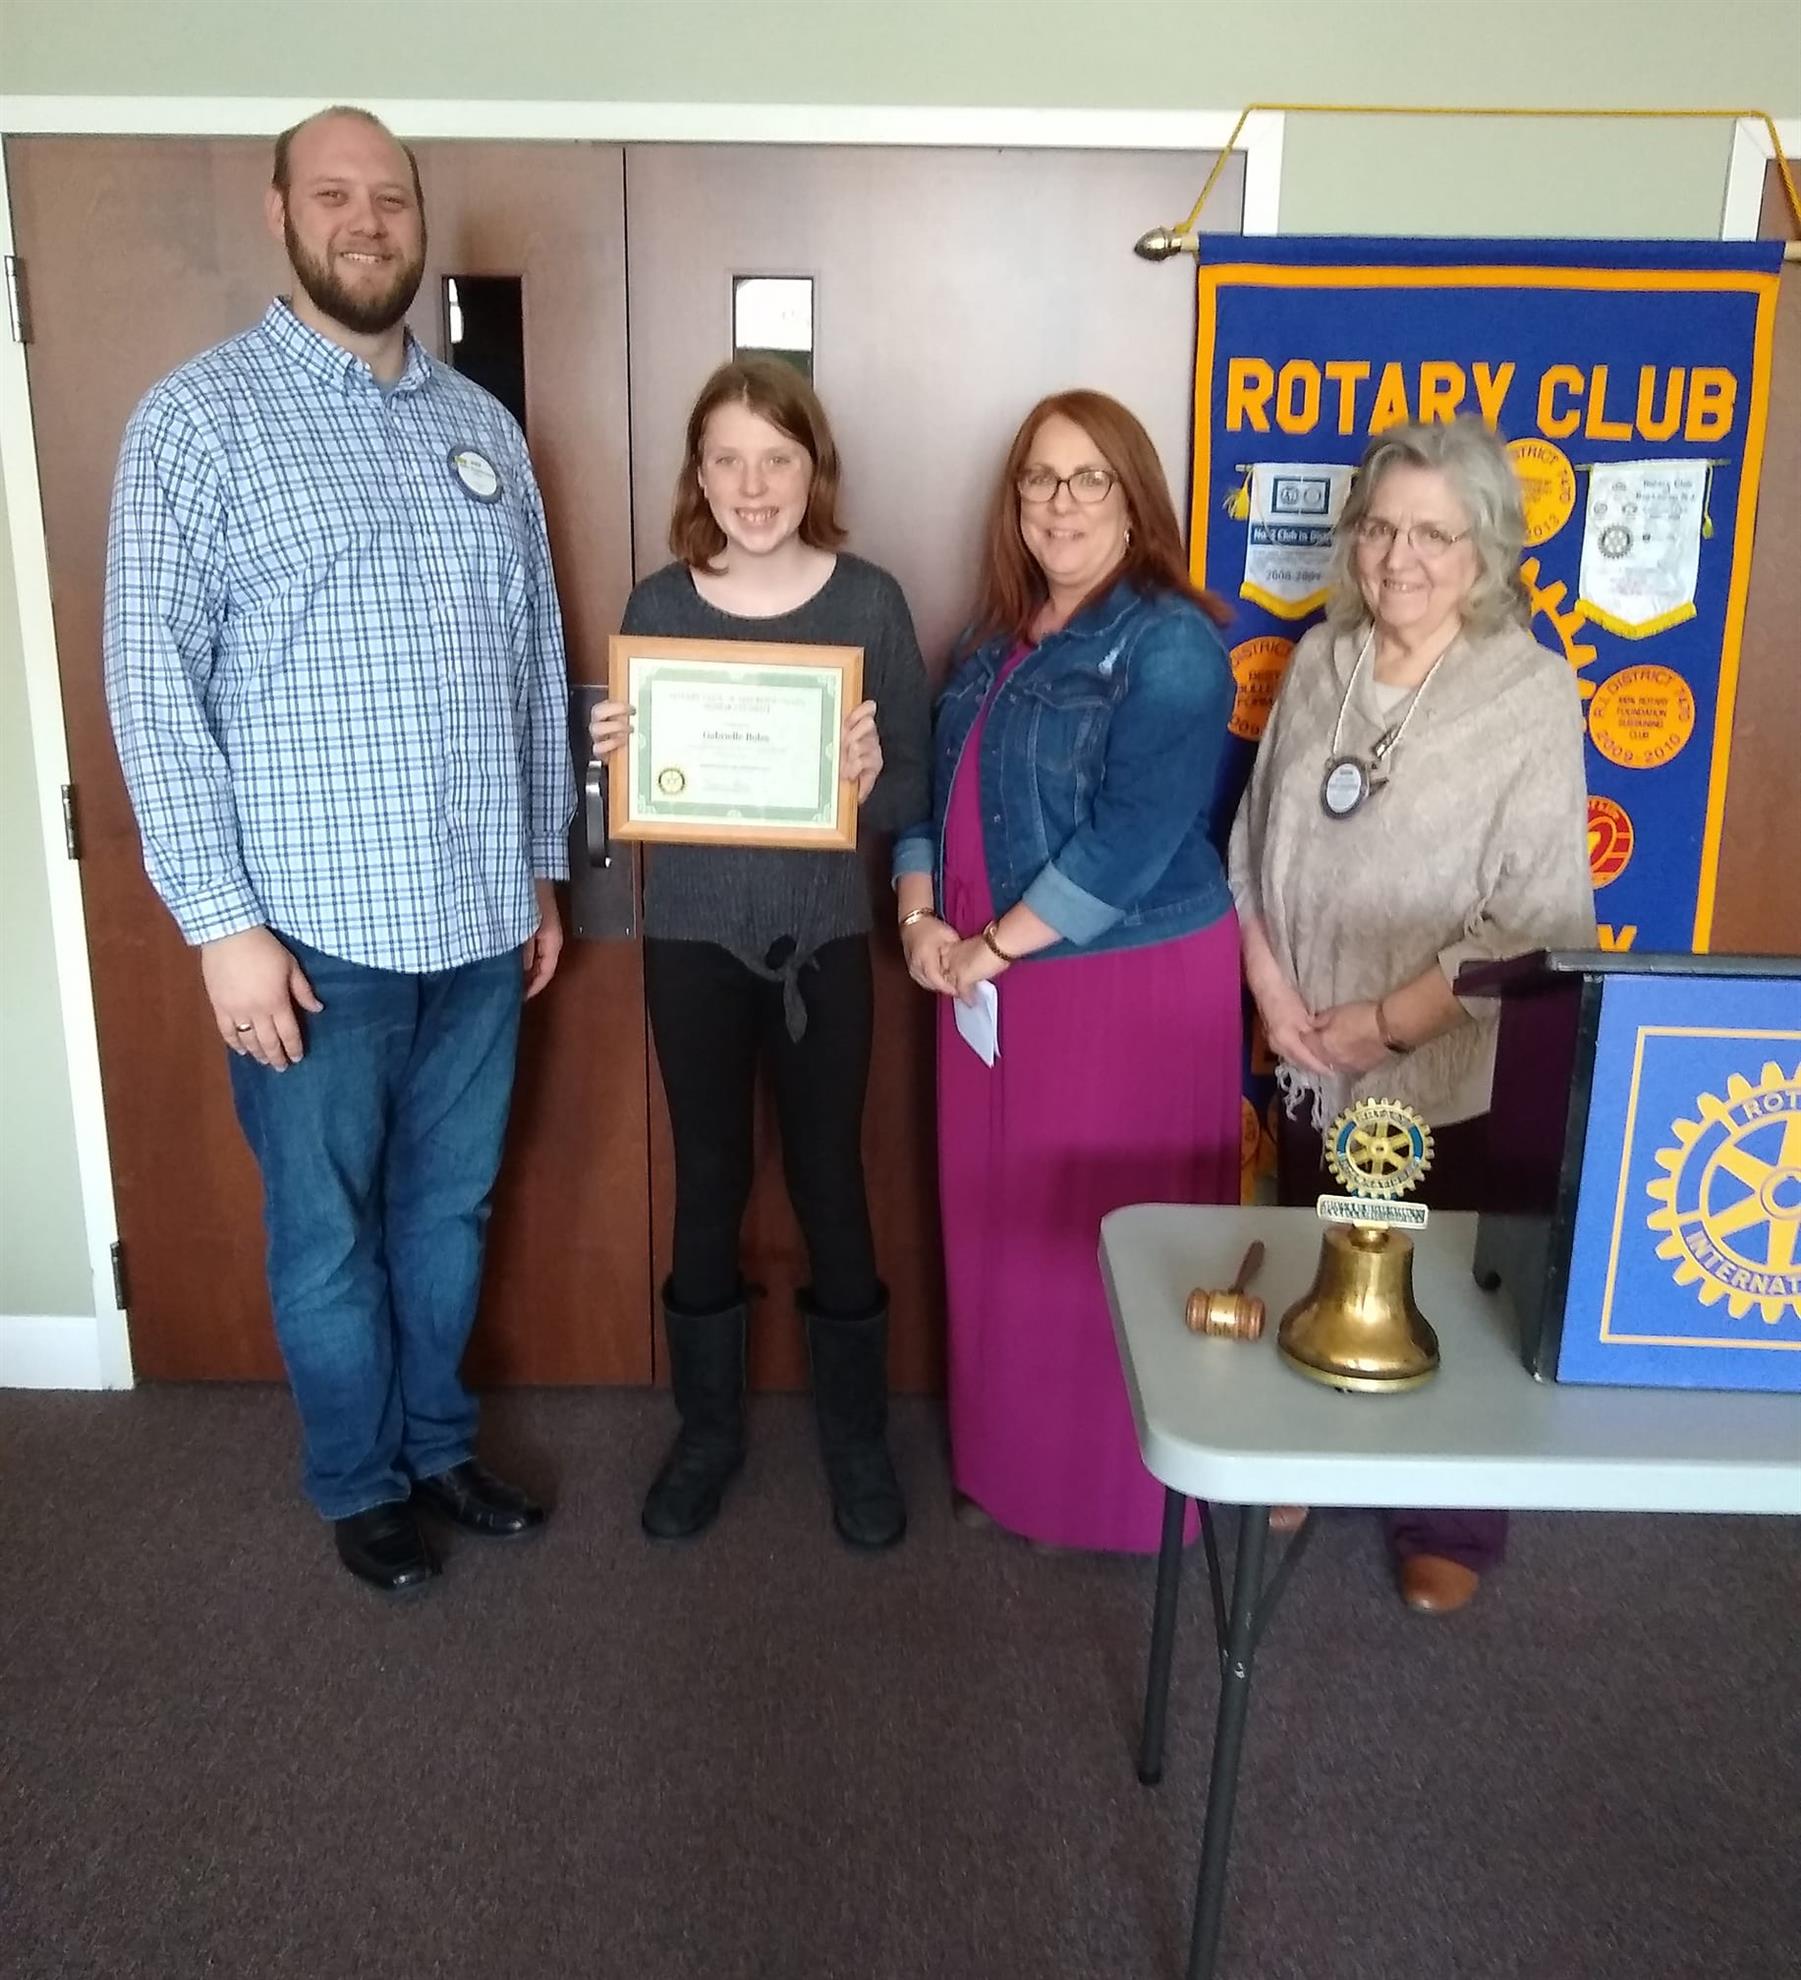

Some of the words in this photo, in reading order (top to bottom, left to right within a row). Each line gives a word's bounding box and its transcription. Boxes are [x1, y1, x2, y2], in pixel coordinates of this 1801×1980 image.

[1226, 357, 1516, 437] ROTARY
[1537, 364, 1738, 443] CLUB
[1606, 670, 1674, 696] DISTRICT
